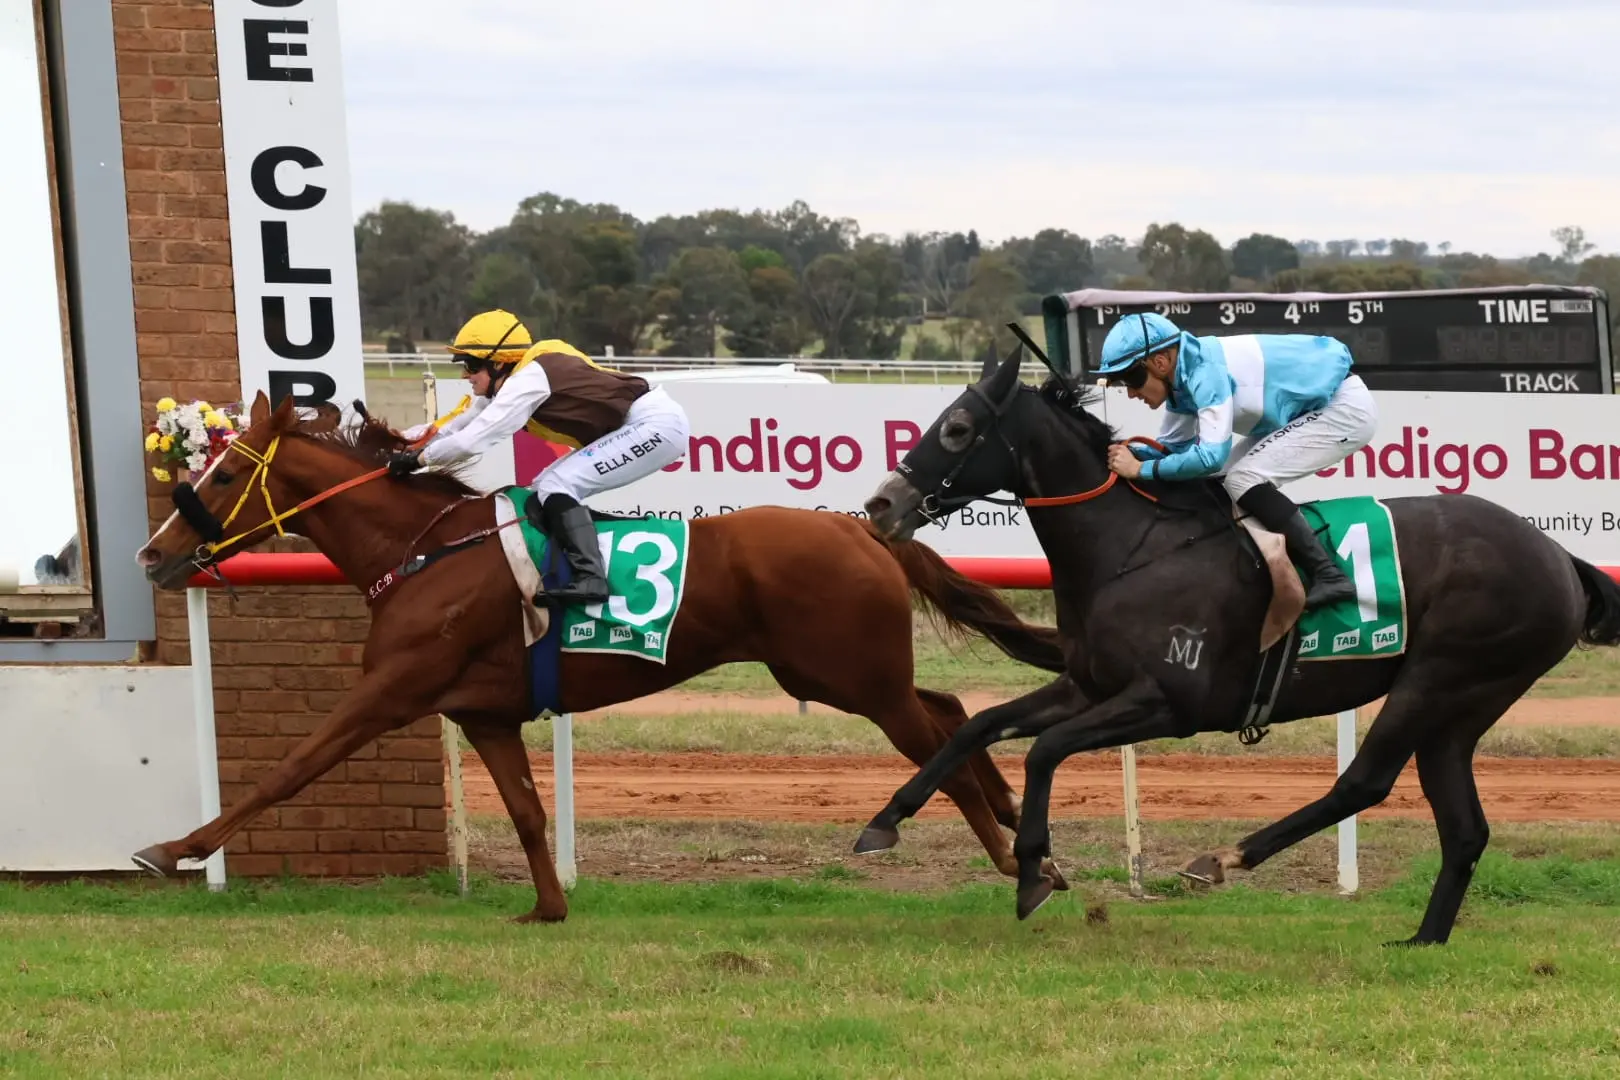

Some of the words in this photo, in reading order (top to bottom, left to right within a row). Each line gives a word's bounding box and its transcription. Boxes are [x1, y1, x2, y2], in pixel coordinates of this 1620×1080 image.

[243, 0, 313, 82] E
[1219, 302, 1256, 325] 3RD
[1284, 302, 1320, 324] 4TH
[1348, 301, 1383, 324] 5TH
[1478, 299, 1549, 323] TIME
[1500, 373, 1579, 392] TRACK
[594, 453, 633, 475] ELLA
[961, 506, 1020, 526] Bank
[1520, 512, 1593, 536] unity
[1336, 522, 1378, 623] 1
[572, 627, 593, 637] TAB
[614, 628, 631, 638] TAB
[1336, 636, 1357, 646] TAB
[1375, 632, 1396, 643] TAB
